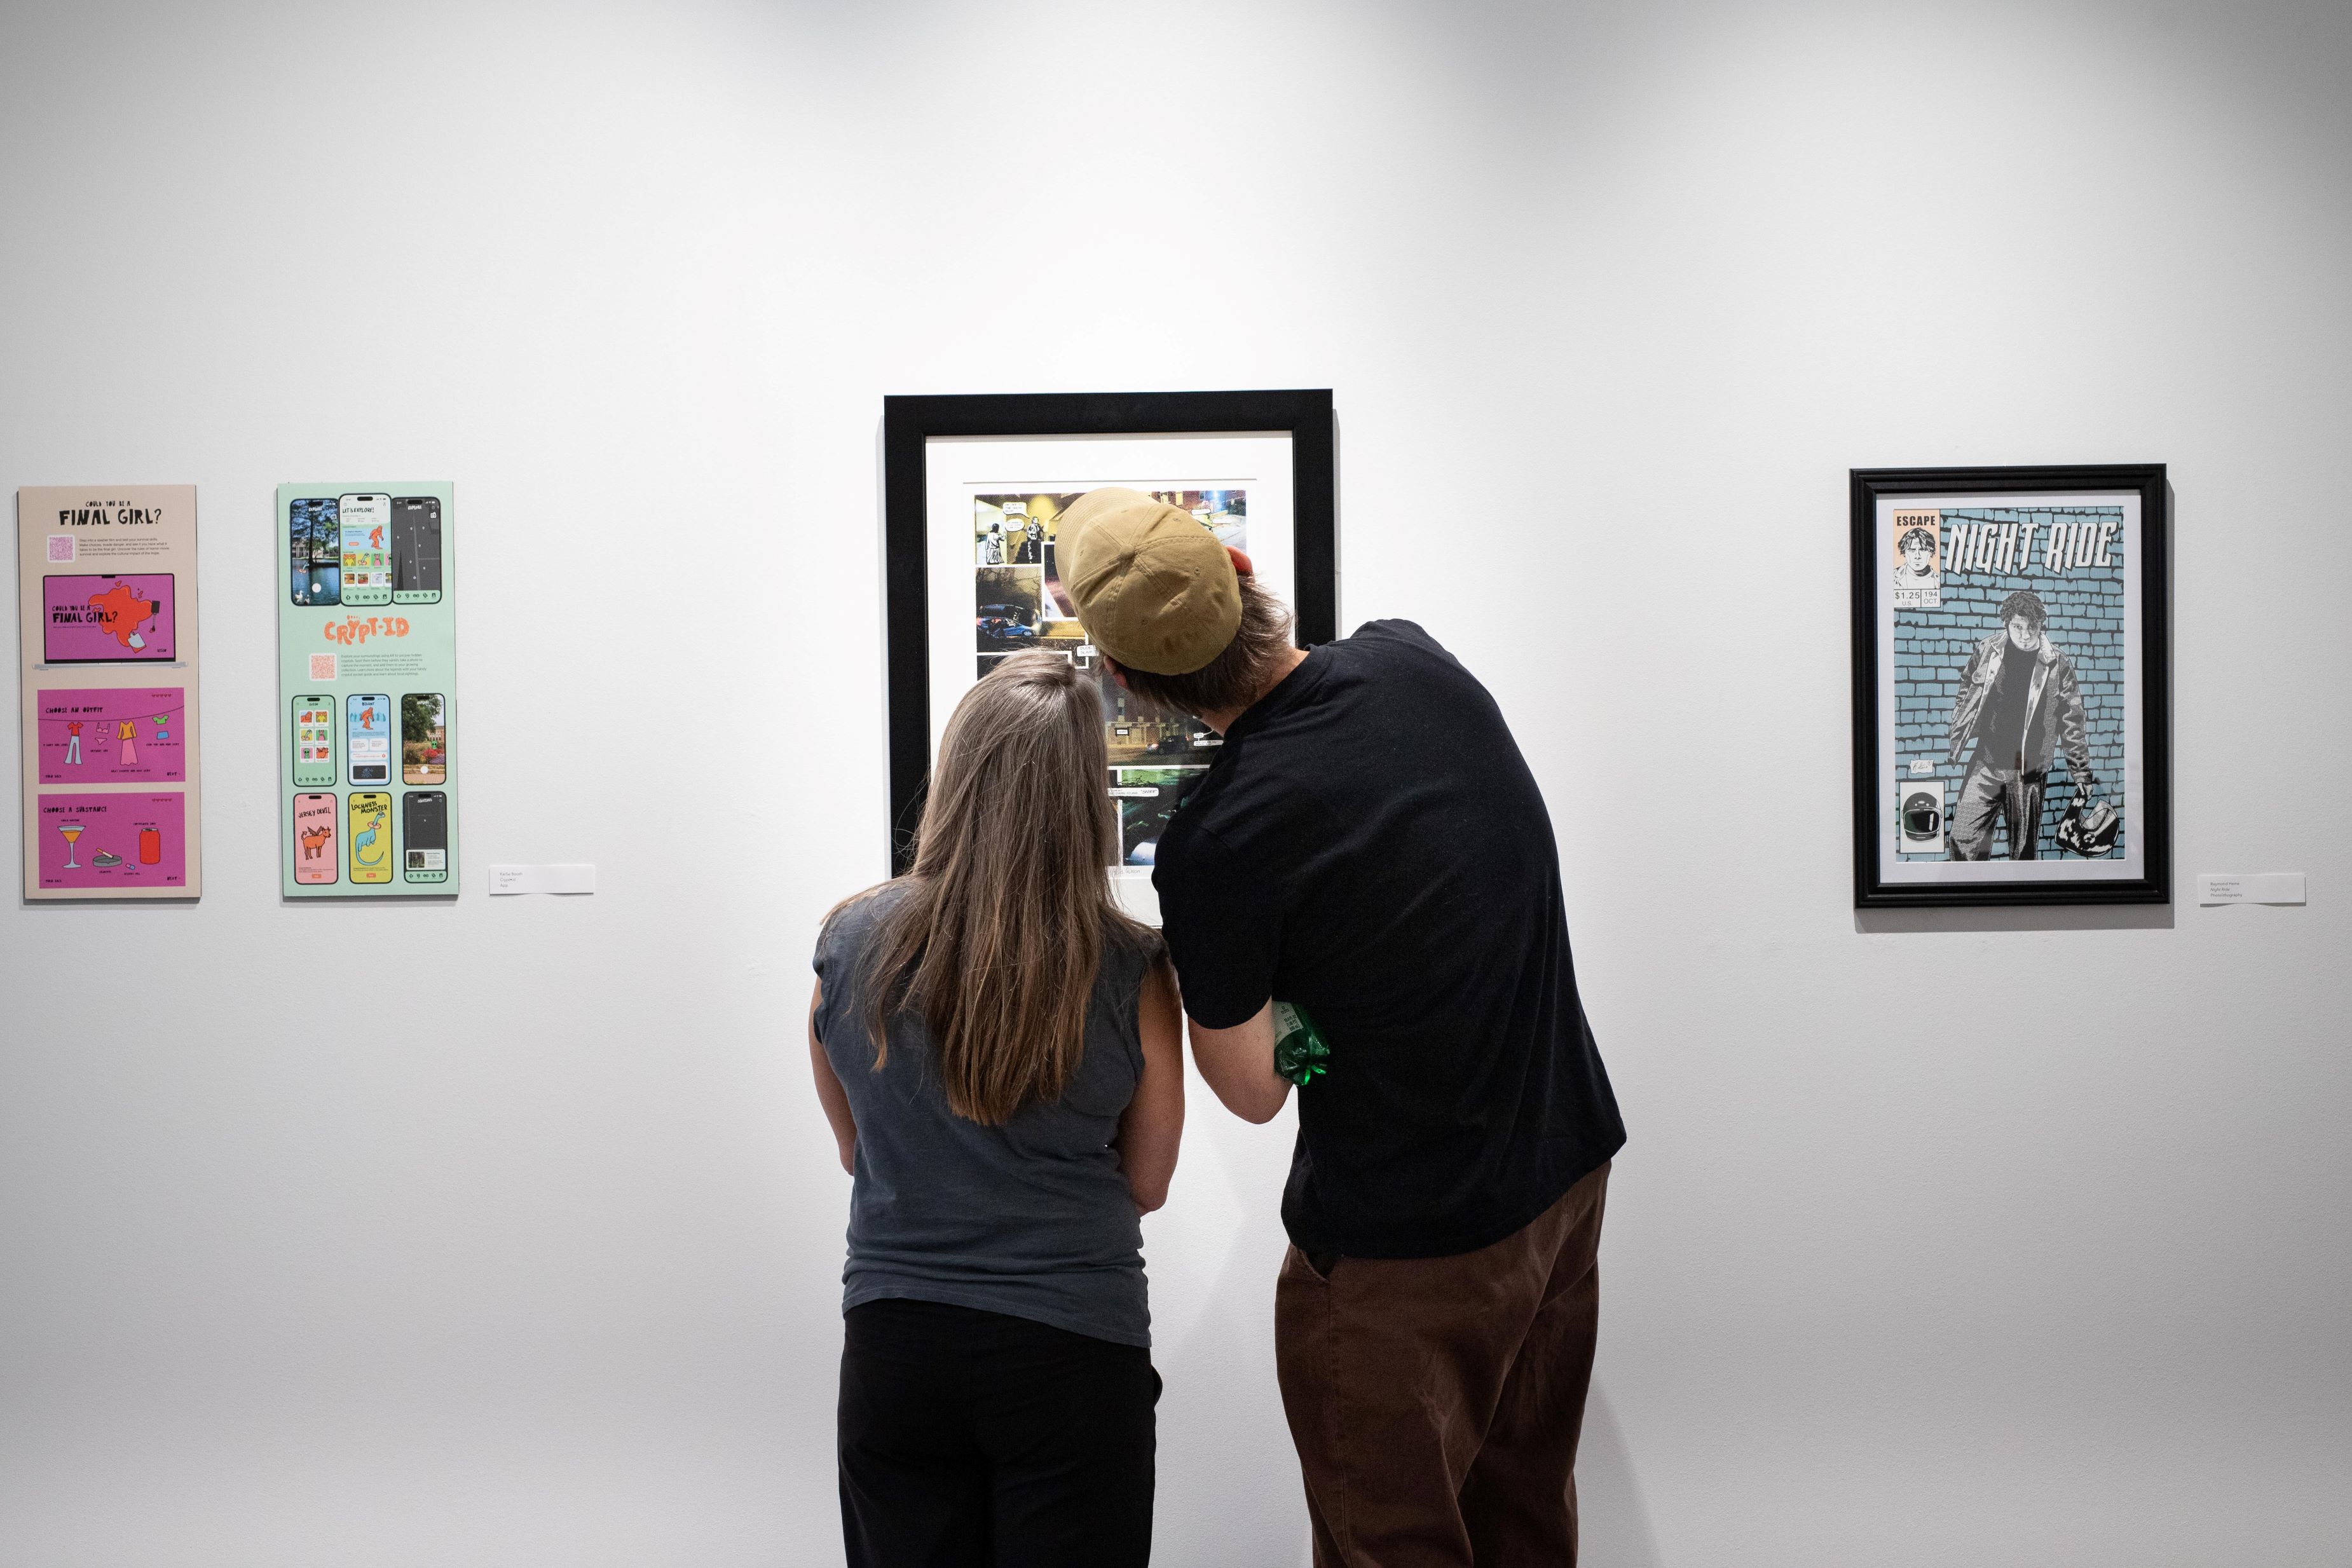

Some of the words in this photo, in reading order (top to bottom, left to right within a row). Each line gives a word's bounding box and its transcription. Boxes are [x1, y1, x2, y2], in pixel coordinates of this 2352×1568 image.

[59, 509, 110, 526] FINAL
[118, 508, 161, 524] GIRL?
[1897, 515, 1935, 526] ESCAPE
[1945, 522, 2040, 576] NIGHT
[2044, 522, 2119, 575] RIDE
[53, 612, 83, 623] FINAL
[86, 611, 118, 623] GIRL?
[324, 615, 409, 645] CRYPT-ID
[351, 801, 377, 811] LOCHNESS
[360, 804, 387, 814] MONSTER
[298, 810, 315, 818] JERSEY
[317, 807, 331, 815] DEVIL
